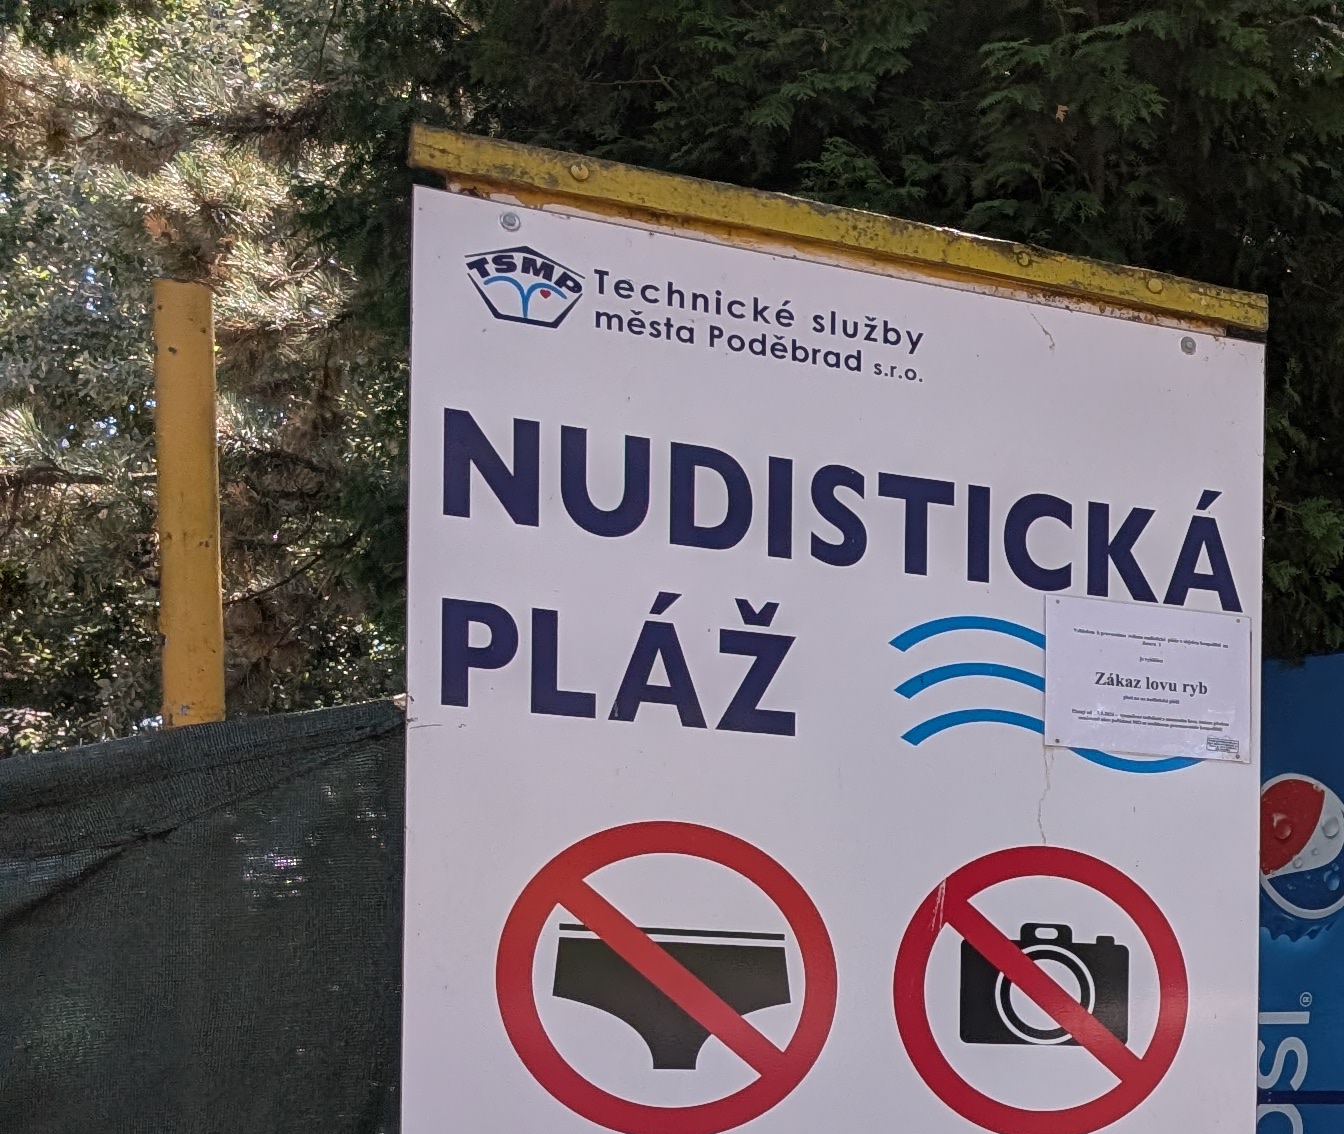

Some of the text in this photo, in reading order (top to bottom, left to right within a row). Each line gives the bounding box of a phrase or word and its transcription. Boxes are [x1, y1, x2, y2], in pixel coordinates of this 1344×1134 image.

[466, 253, 583, 294] TSMP
[593, 268, 924, 355] Technické služby
[594, 309, 924, 383] města Poděbrad s.r.o.
[443, 407, 1243, 613] NUDISTICKÁ
[441, 591, 797, 737] PLÁŽ
[1095, 671, 1208, 697] Zákaz lovu ryb
